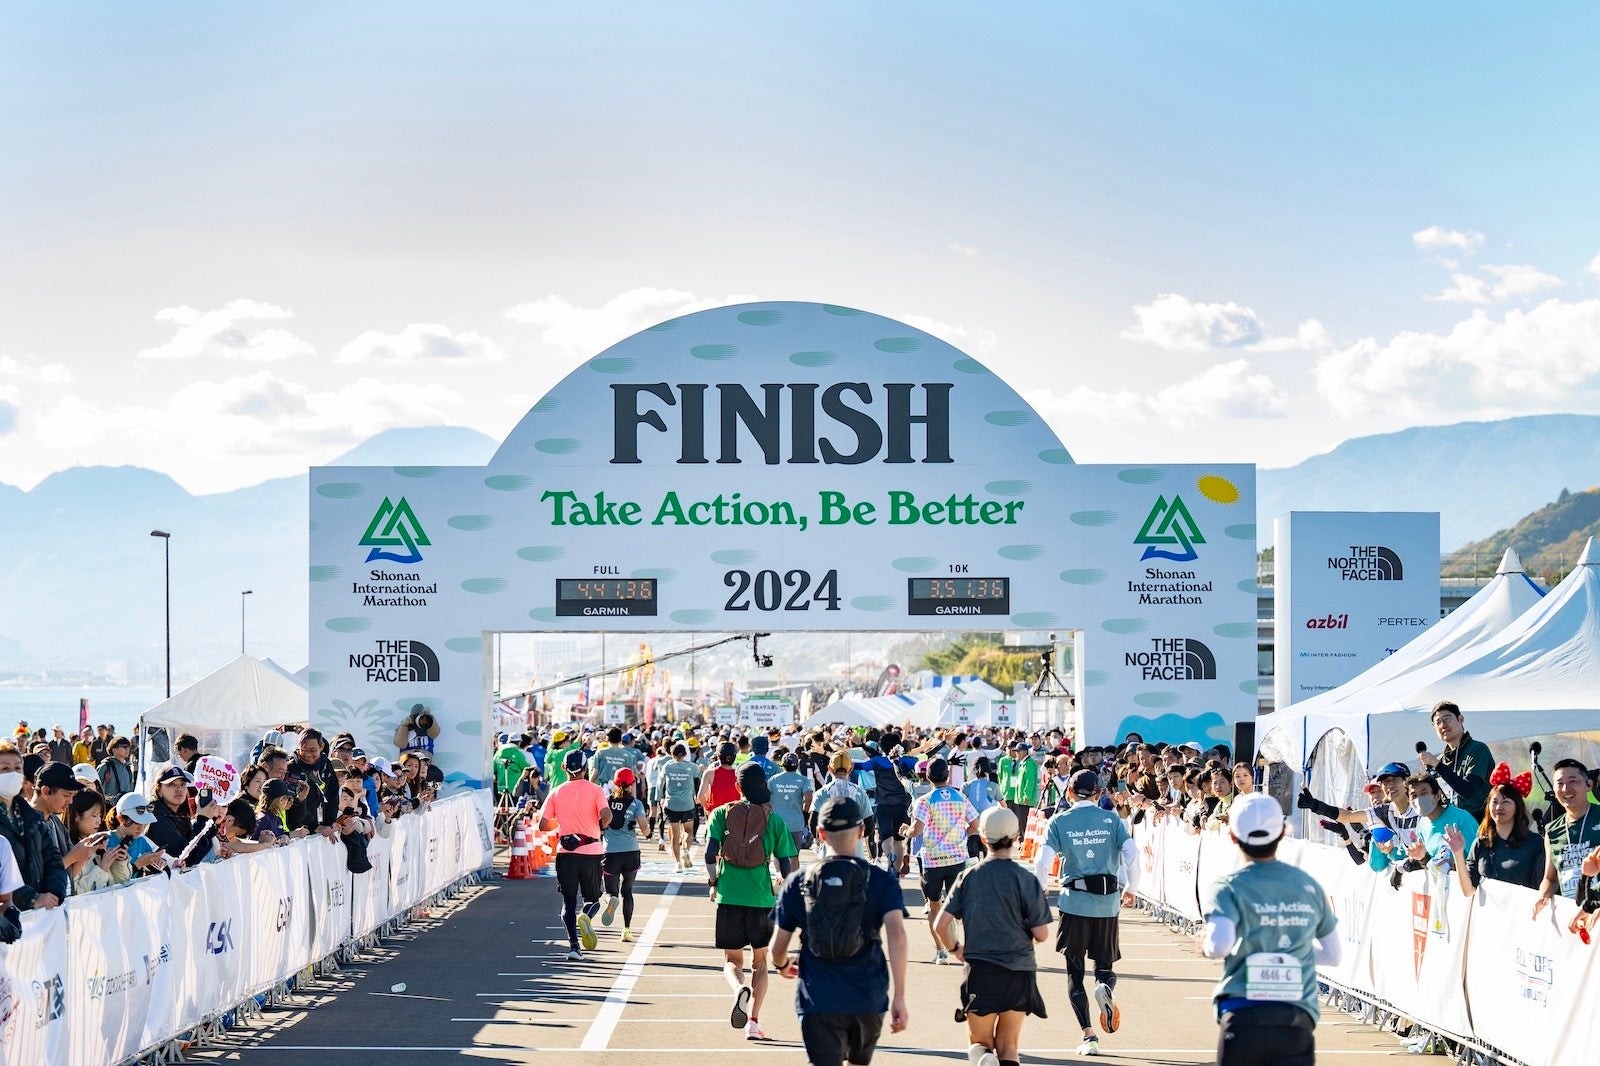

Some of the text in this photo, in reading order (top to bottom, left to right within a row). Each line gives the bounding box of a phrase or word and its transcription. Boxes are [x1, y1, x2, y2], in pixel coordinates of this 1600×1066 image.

[609, 382, 955, 465] FINISH
[540, 490, 1025, 532] Take Action, Be Better
[1349, 546, 1377, 557] THE
[948, 564, 969, 573] 10K
[1327, 558, 1377, 569] NORTH
[370, 569, 421, 581] Shonan
[593, 566, 620, 575] FULL
[1145, 568, 1196, 579] Shonan
[1342, 569, 1377, 581] FACE
[352, 583, 437, 594] International
[723, 569, 842, 611] 2024
[1127, 581, 1213, 592] International
[363, 595, 427, 606] Marathon
[1138, 594, 1203, 604] Marathon
[583, 607, 630, 615] GARMIN
[935, 606, 982, 614] GARMIN
[1306, 614, 1349, 629] azbil
[375, 640, 408, 653] THE
[1151, 638, 1184, 652] THE
[349, 654, 408, 668] NORTH
[1125, 652, 1184, 666] NORTH
[366, 668, 408, 682] FACE
[1142, 666, 1184, 680] FACE
[203, 764, 234, 782] NAORU
[1252, 903, 1278, 914] Take
[1260, 915, 1309, 927] Be Better
